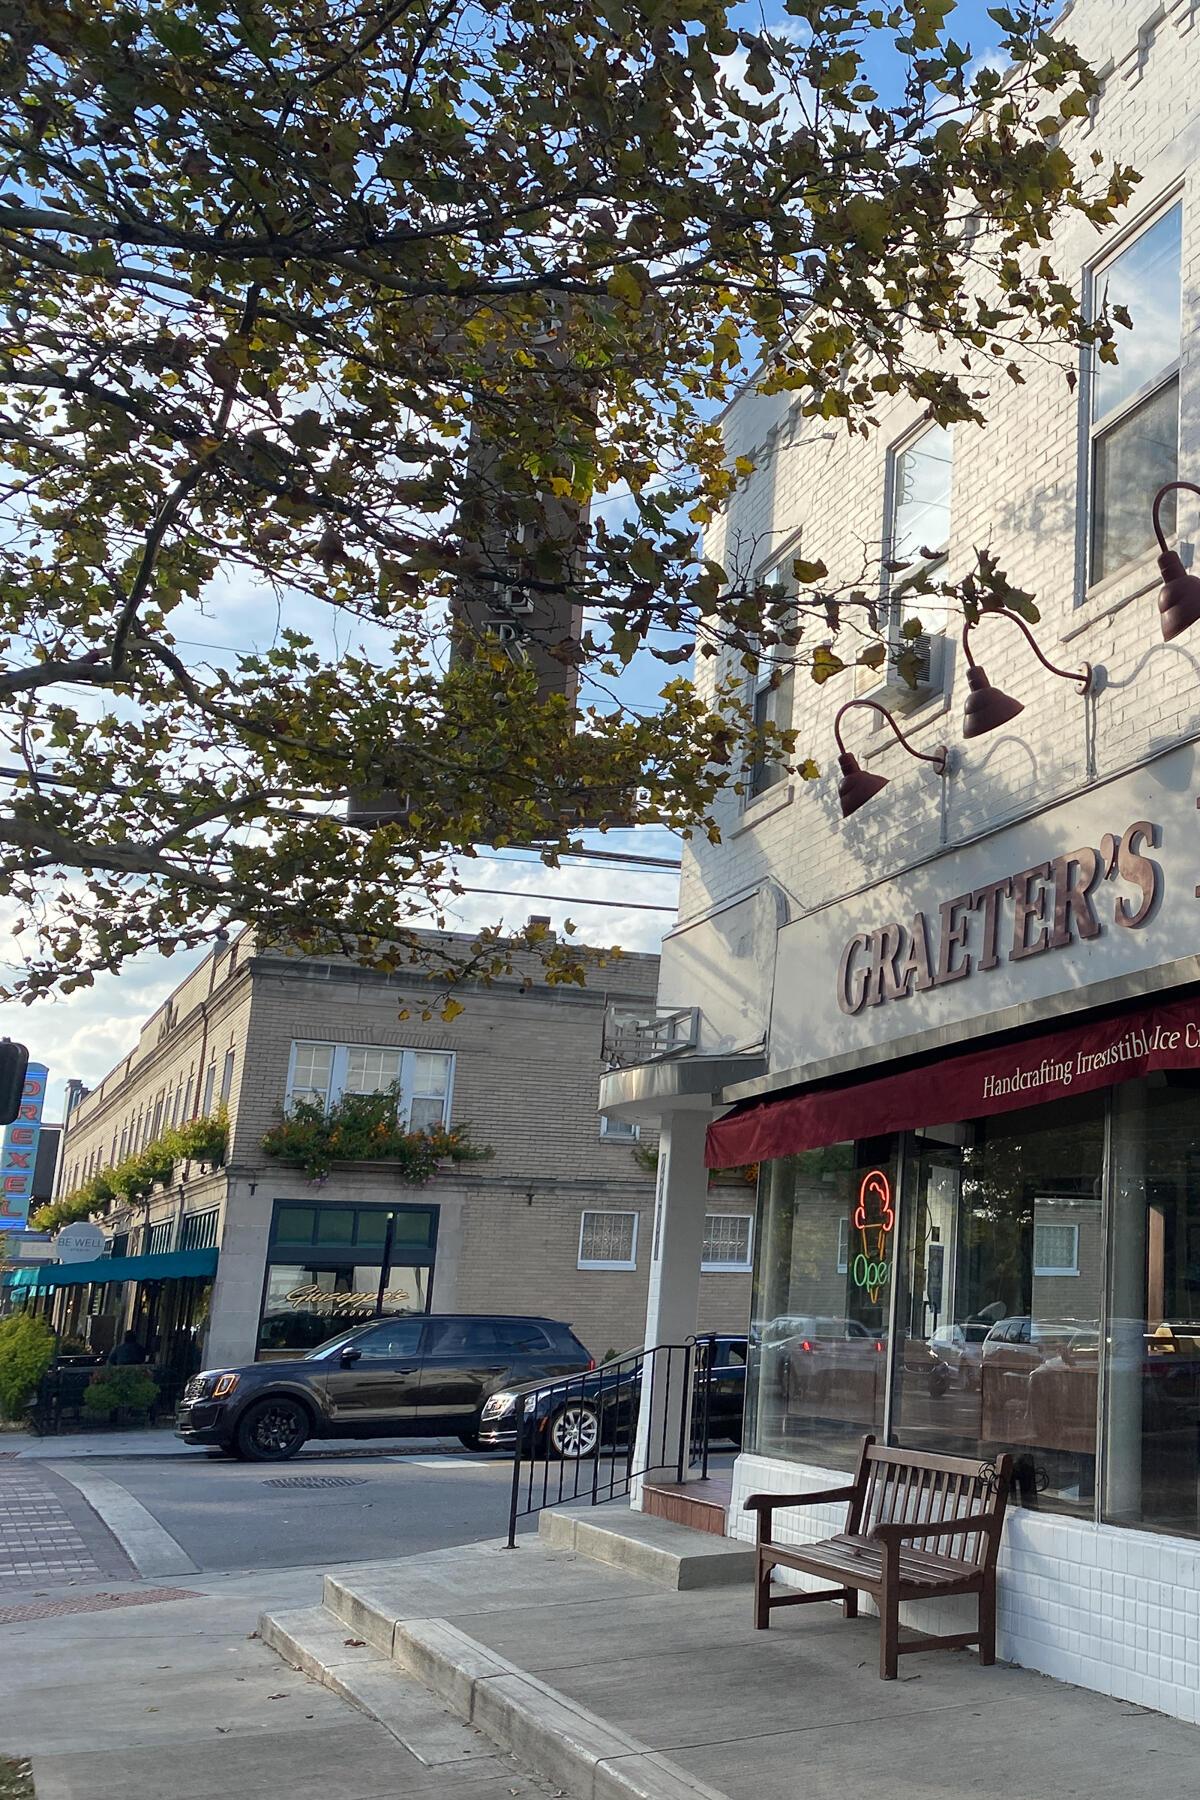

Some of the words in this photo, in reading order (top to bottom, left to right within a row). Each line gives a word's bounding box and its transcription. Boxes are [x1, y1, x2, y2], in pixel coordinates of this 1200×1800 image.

[836, 820, 1161, 1015] GRAETER'S
[983, 1058, 1073, 1099] Handcrafting
[1076, 1028, 1152, 1075] Irresistibl
[1152, 1025, 1180, 1050] Ice
